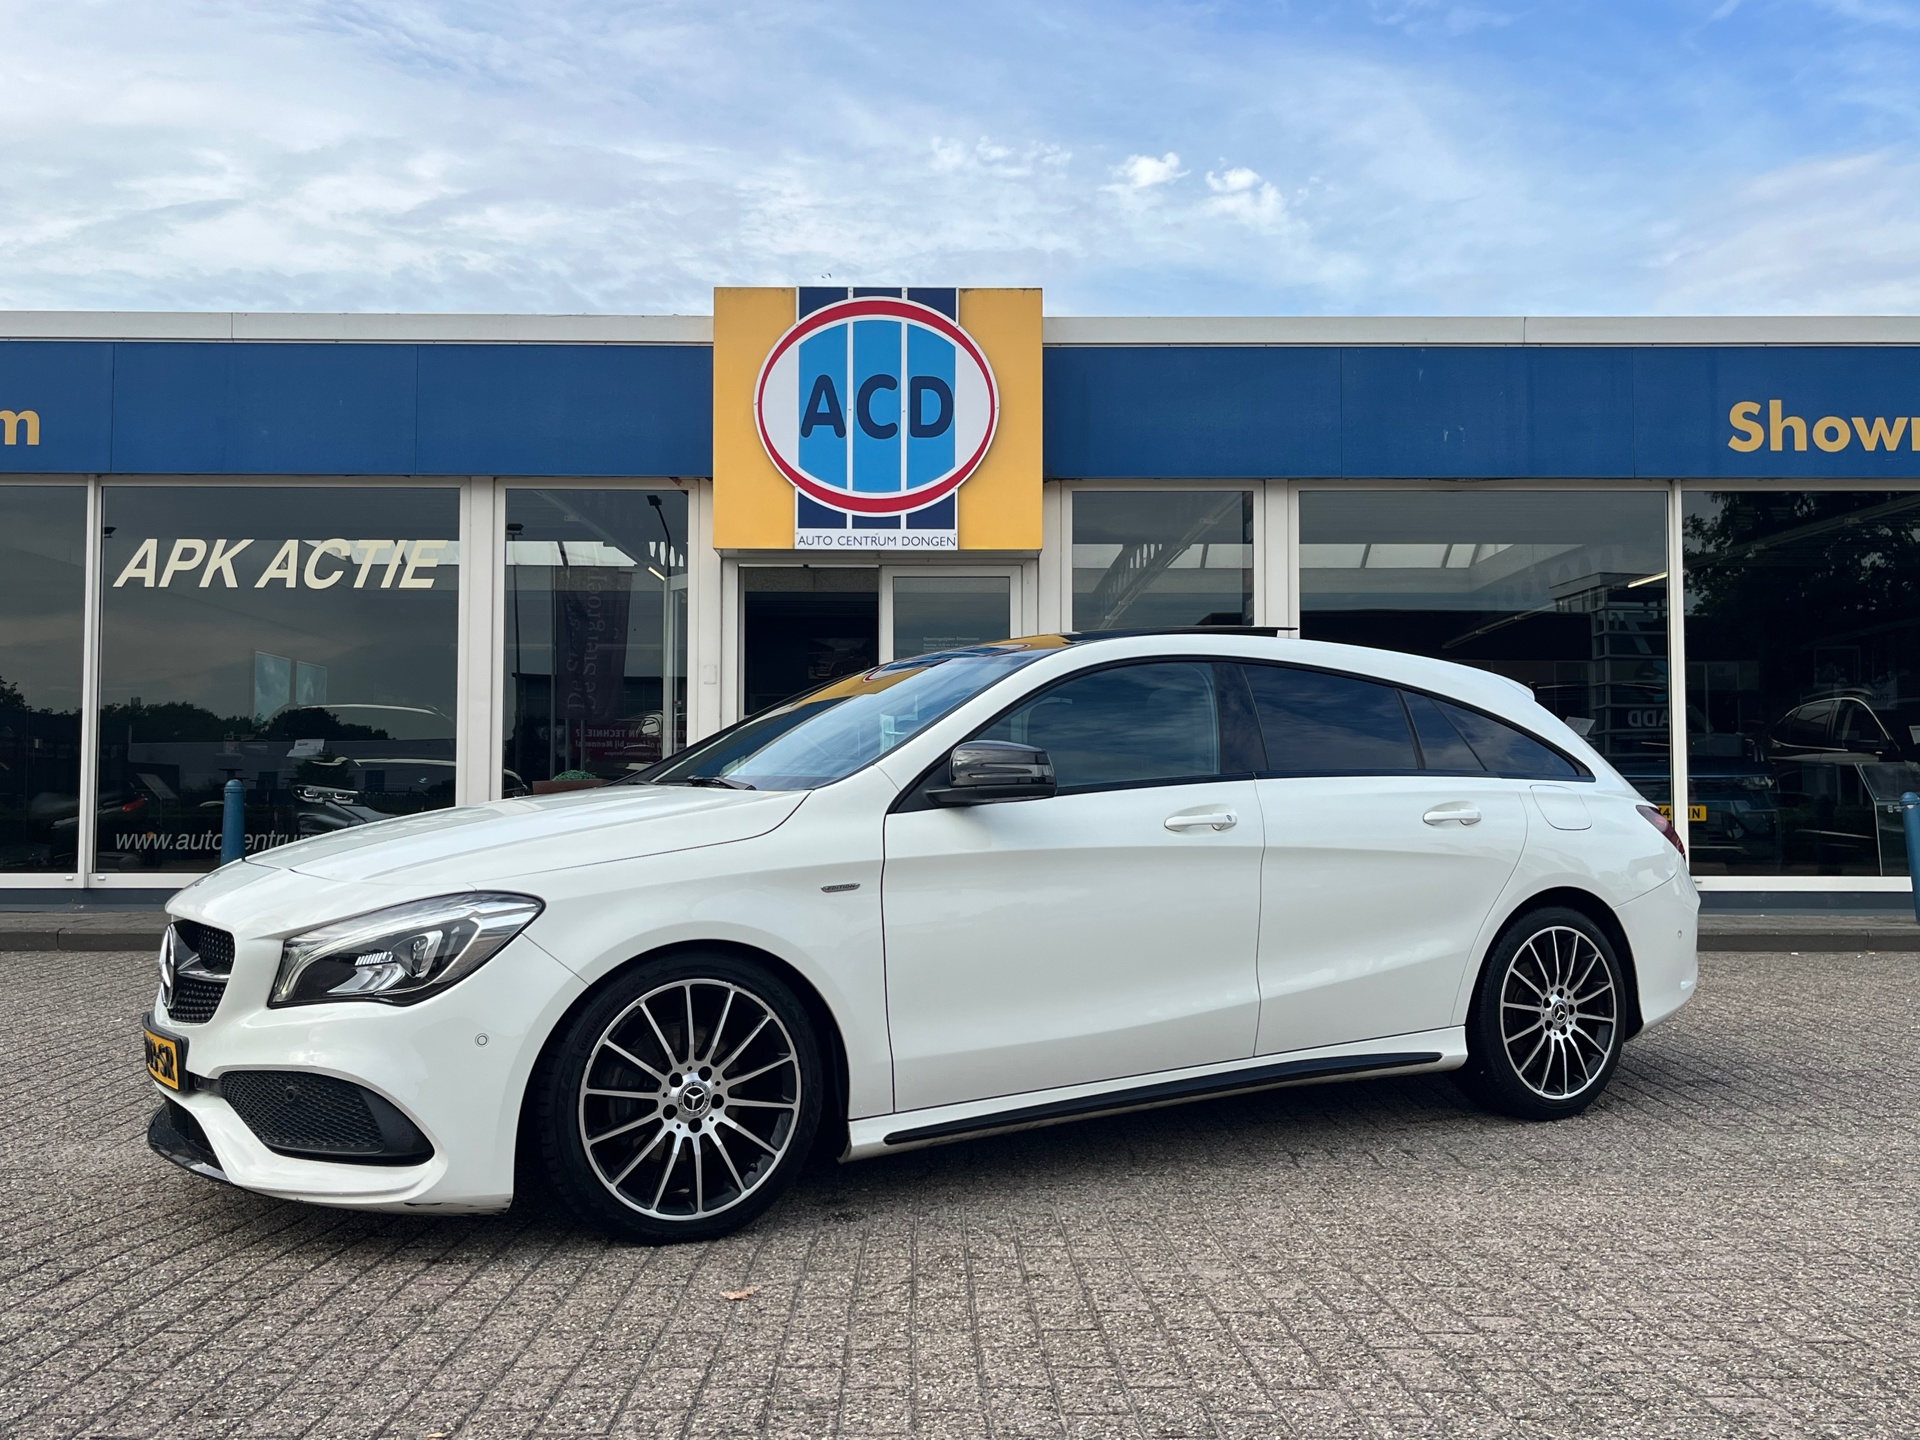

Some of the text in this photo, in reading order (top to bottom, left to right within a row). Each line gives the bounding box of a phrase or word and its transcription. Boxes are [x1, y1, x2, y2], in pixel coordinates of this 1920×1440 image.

[801, 374, 954, 439] ACD
[112, 538, 448, 589] APK ACTIE
[798, 536, 956, 547] AUTO CENTRUM DONGEN
